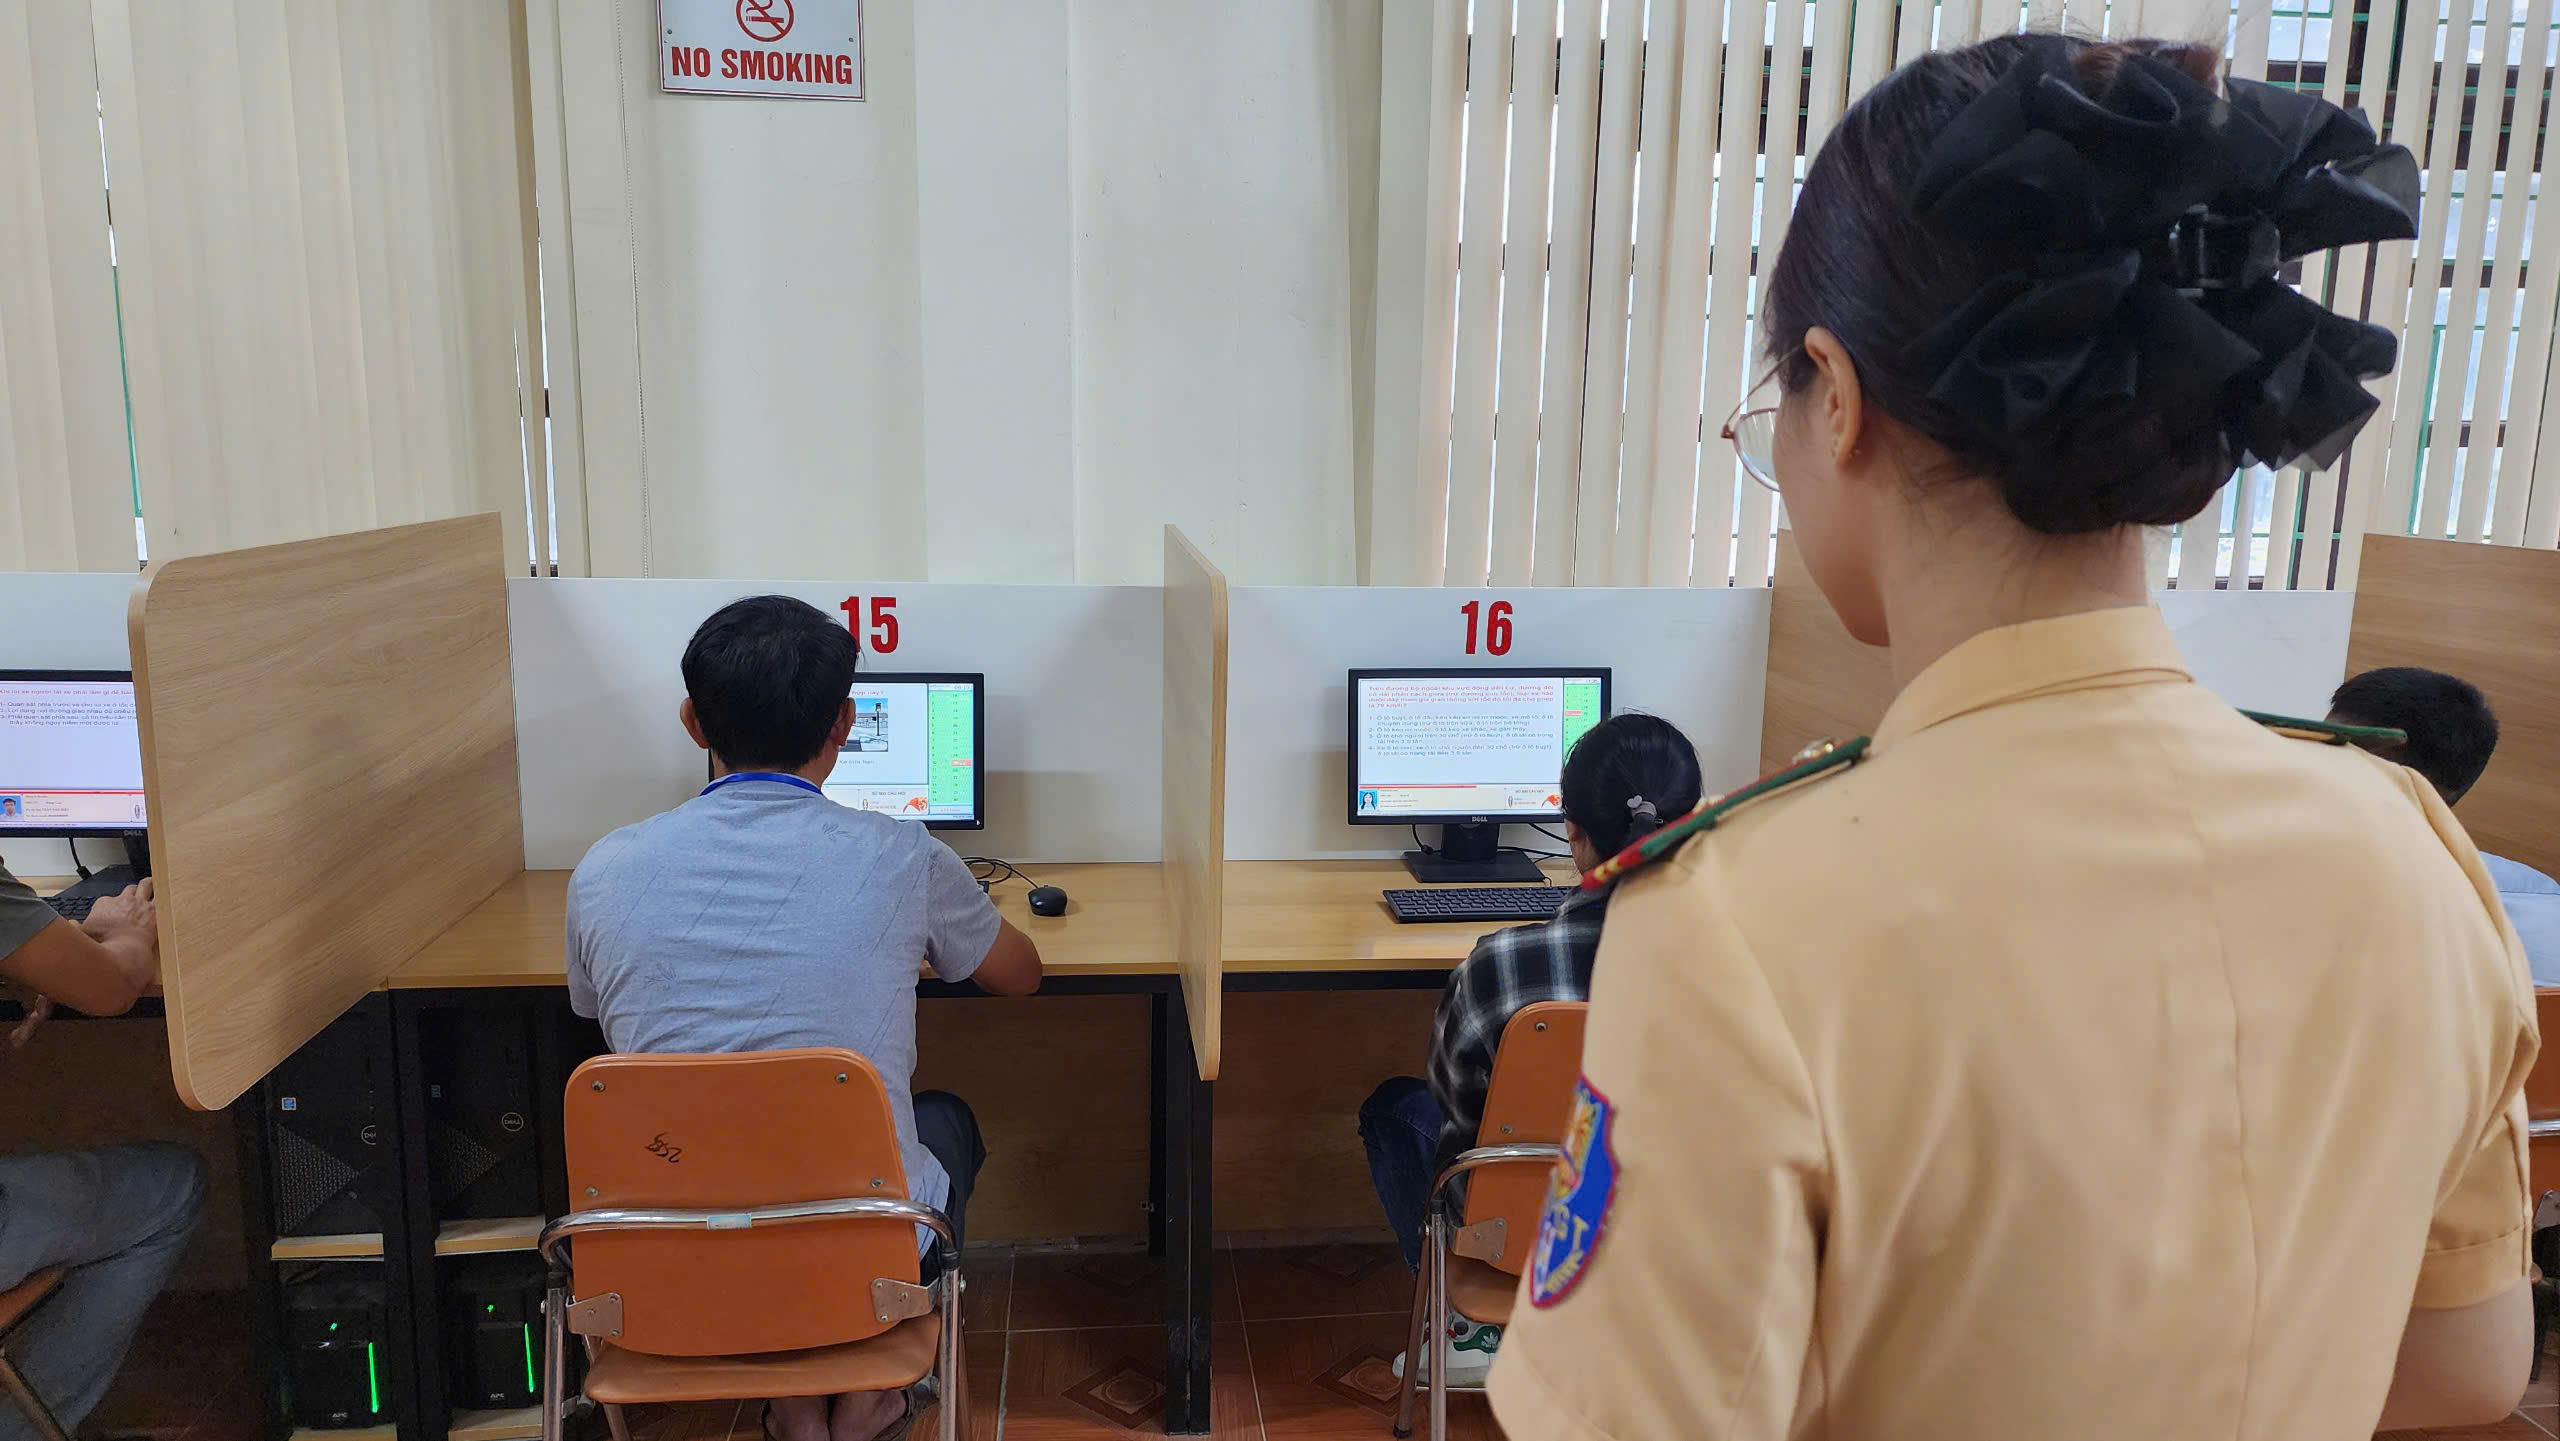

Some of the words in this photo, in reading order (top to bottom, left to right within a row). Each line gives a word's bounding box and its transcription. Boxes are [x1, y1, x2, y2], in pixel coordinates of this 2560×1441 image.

[671, 46, 710, 78] NO
[721, 48, 852, 85] SMOKING
[840, 596, 899, 654] 15
[1461, 600, 1513, 657] 16
